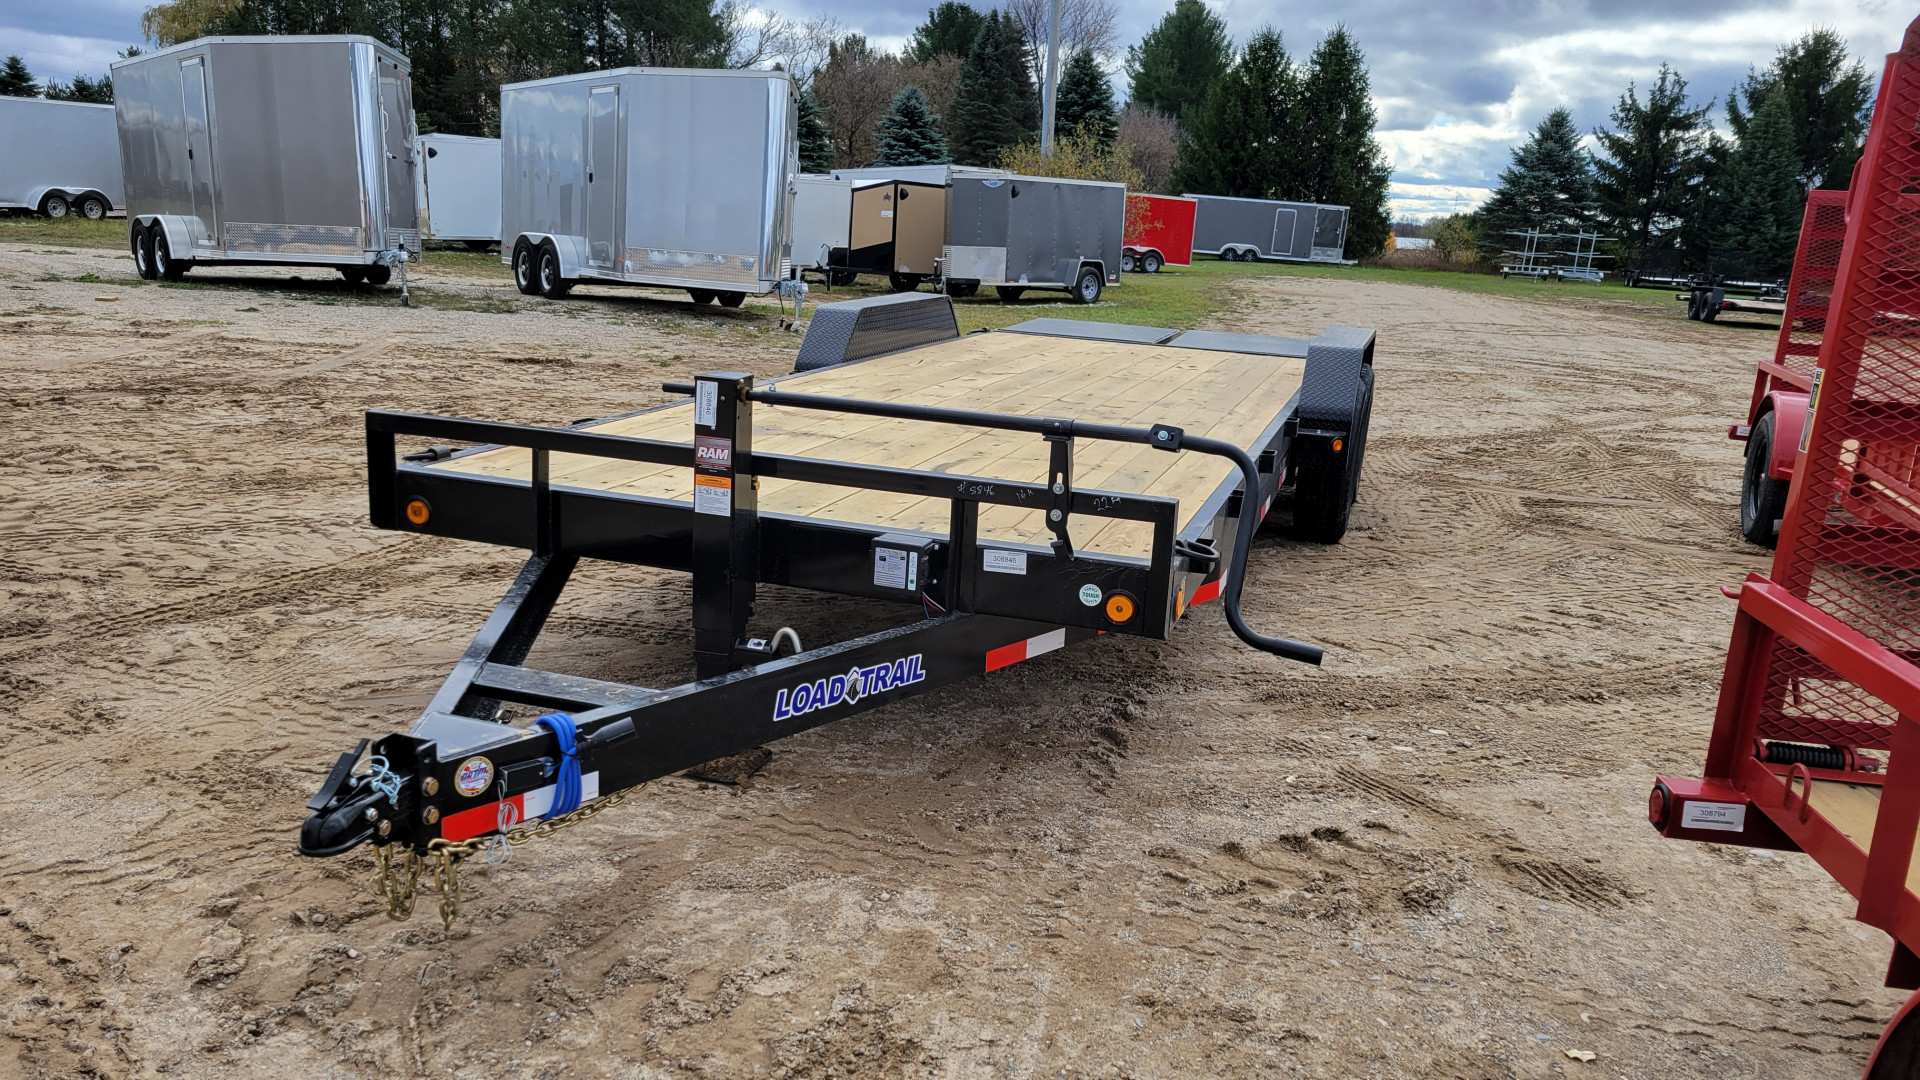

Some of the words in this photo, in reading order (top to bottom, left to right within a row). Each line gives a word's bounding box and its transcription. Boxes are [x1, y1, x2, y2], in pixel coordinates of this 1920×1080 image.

[698, 446, 729, 460] RAM
[773, 673, 848, 722] LOAD
[859, 653, 926, 698] TRAIL
[1700, 809, 1727, 817] 308794
